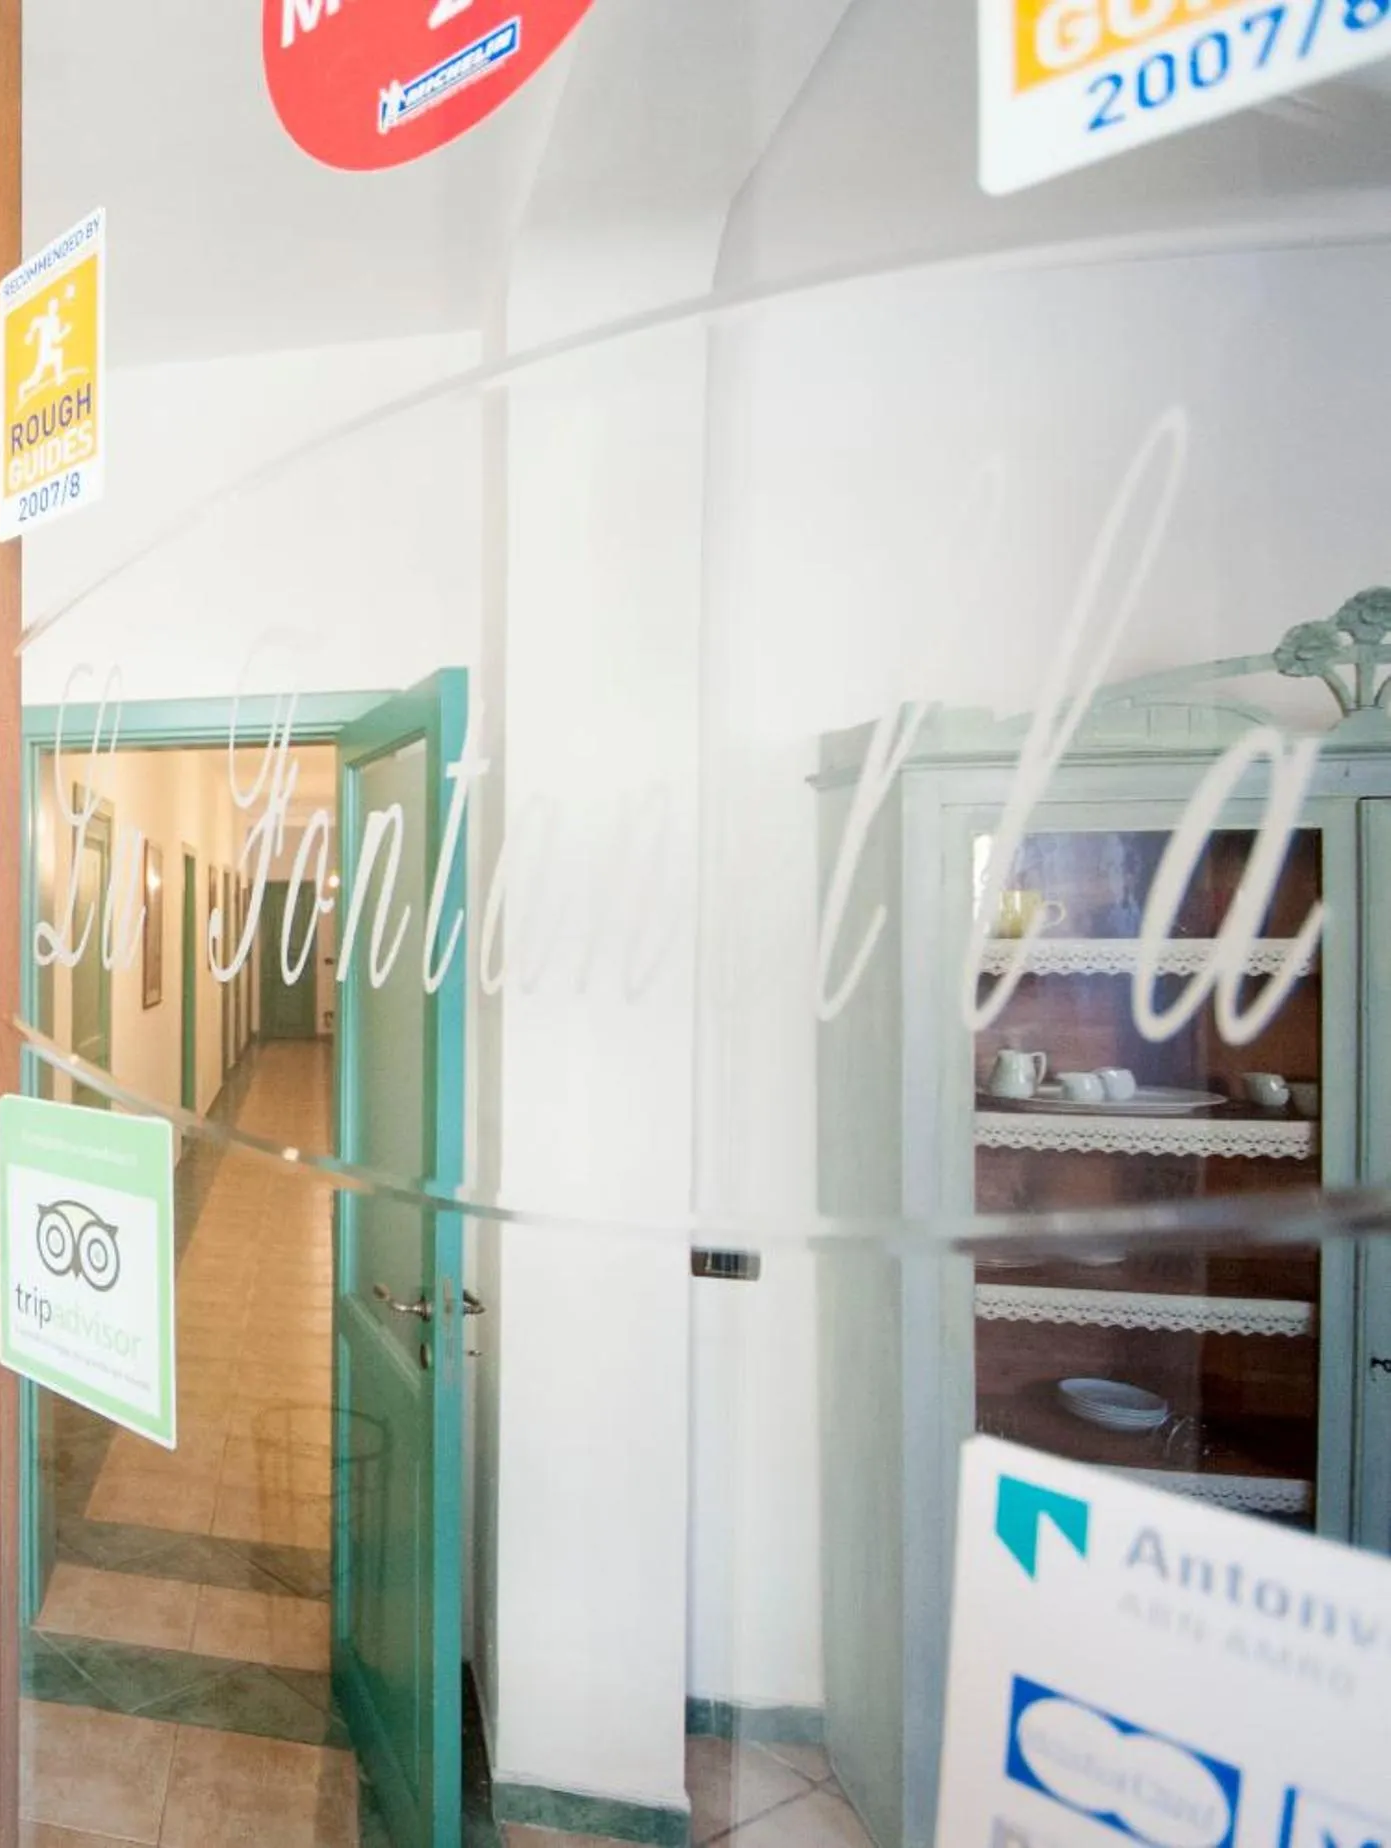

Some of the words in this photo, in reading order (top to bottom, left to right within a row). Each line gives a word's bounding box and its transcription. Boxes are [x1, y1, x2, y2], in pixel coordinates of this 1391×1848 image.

[3, 228, 85, 298] RECOMMENDED
[85, 214, 102, 241] BY
[11, 383, 92, 453] ROUGH
[8, 420, 95, 490] GUIDES
[18, 472, 81, 522] 2007/8
[15, 1283, 142, 1360] tripadvisor
[1123, 1524, 1391, 1652] Antonv
